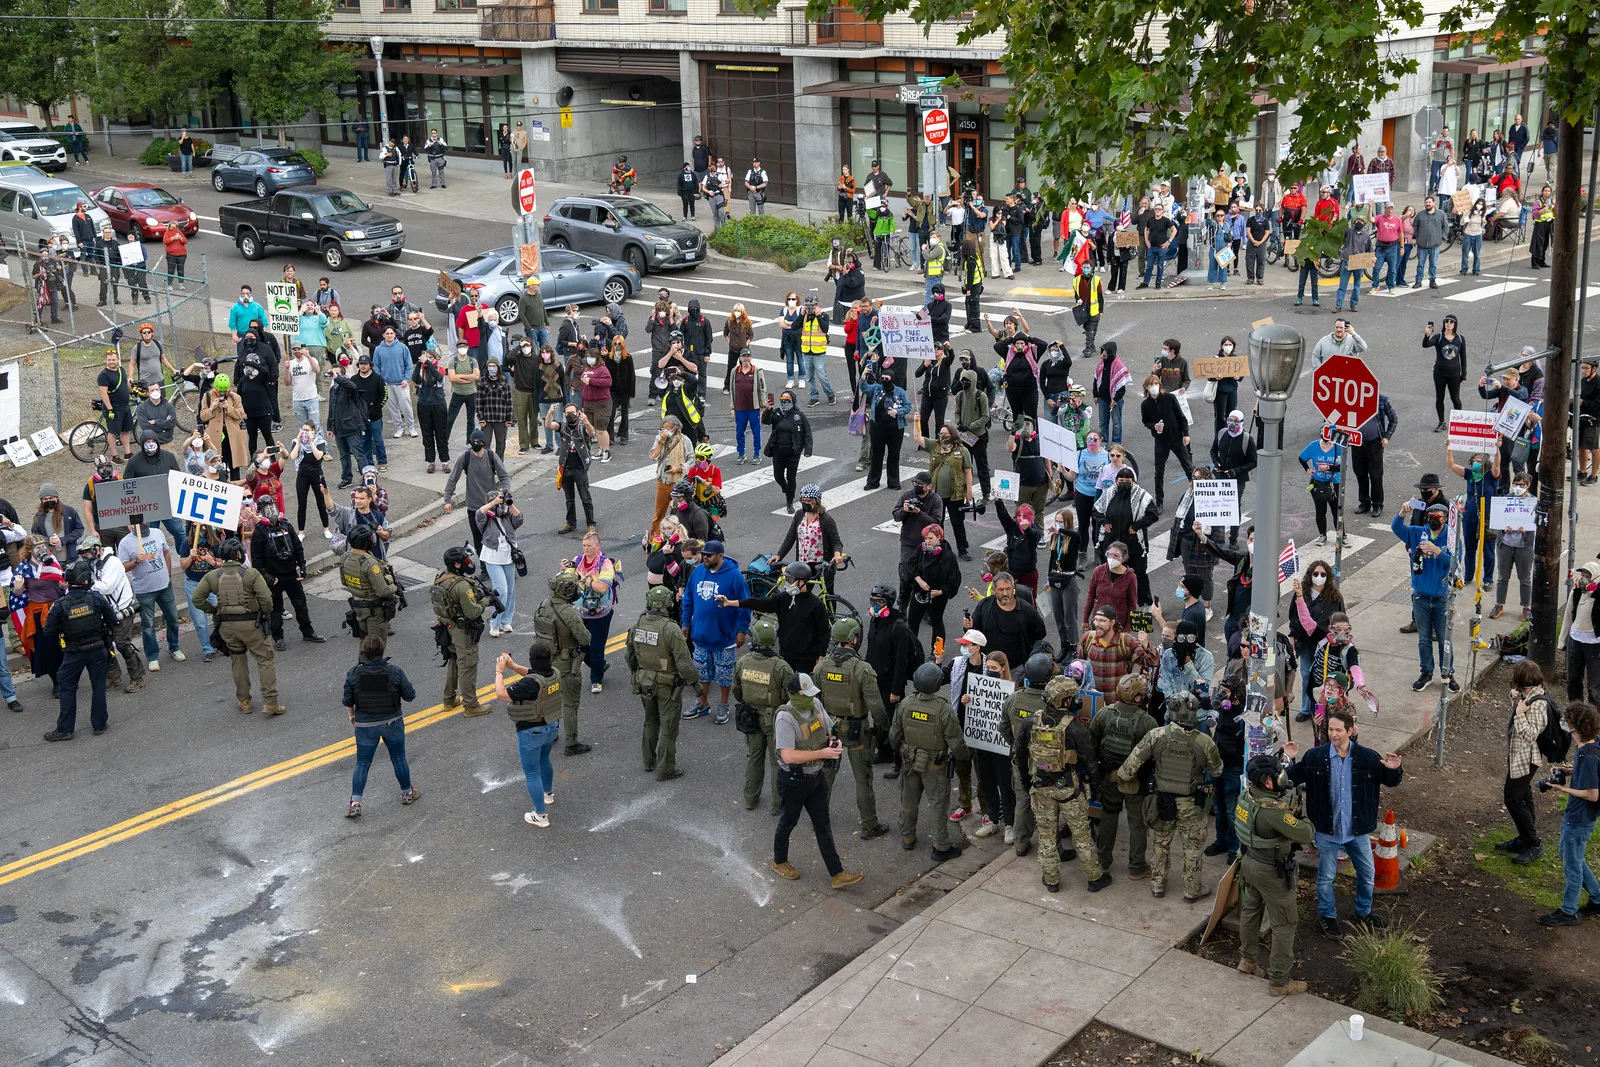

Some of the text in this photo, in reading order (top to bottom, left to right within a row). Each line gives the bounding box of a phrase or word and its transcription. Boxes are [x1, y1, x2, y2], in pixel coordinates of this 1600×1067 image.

[960, 121, 976, 129] 4150
[929, 131, 945, 139] ENTER
[522, 197, 533, 205] ENTER
[267, 285, 296, 297] NOT UR
[270, 314, 298, 324] TRAINING
[271, 322, 299, 333] GROUND
[882, 330, 903, 344] YES
[886, 344, 903, 356] NO
[1197, 362, 1217, 377] ICE
[1317, 375, 1375, 408] STOP
[123, 480, 137, 490] ICE
[182, 477, 228, 494] ABOLISH
[120, 495, 140, 505] NAZI
[1506, 497, 1525, 507] ICE
[98, 503, 159, 518] BROWNSHIRTS
[177, 489, 228, 524] ICE
[343, 573, 361, 585] POLICE
[71, 605, 89, 615] POLICE
[743, 668, 771, 681] Federal
[827, 672, 843, 681] POLICE
[547, 682, 559, 695] ERO
[975, 676, 1001, 690] YOUR
[968, 685, 1009, 701] HUMANIT
[971, 698, 1004, 711] IS MOR
[912, 711, 928, 721] POLICE
[966, 707, 1002, 721] IMPORTAN
[810, 720, 821, 732] HSI
[967, 716, 1000, 732] THAN YOU
[965, 726, 993, 743] ORDERS
